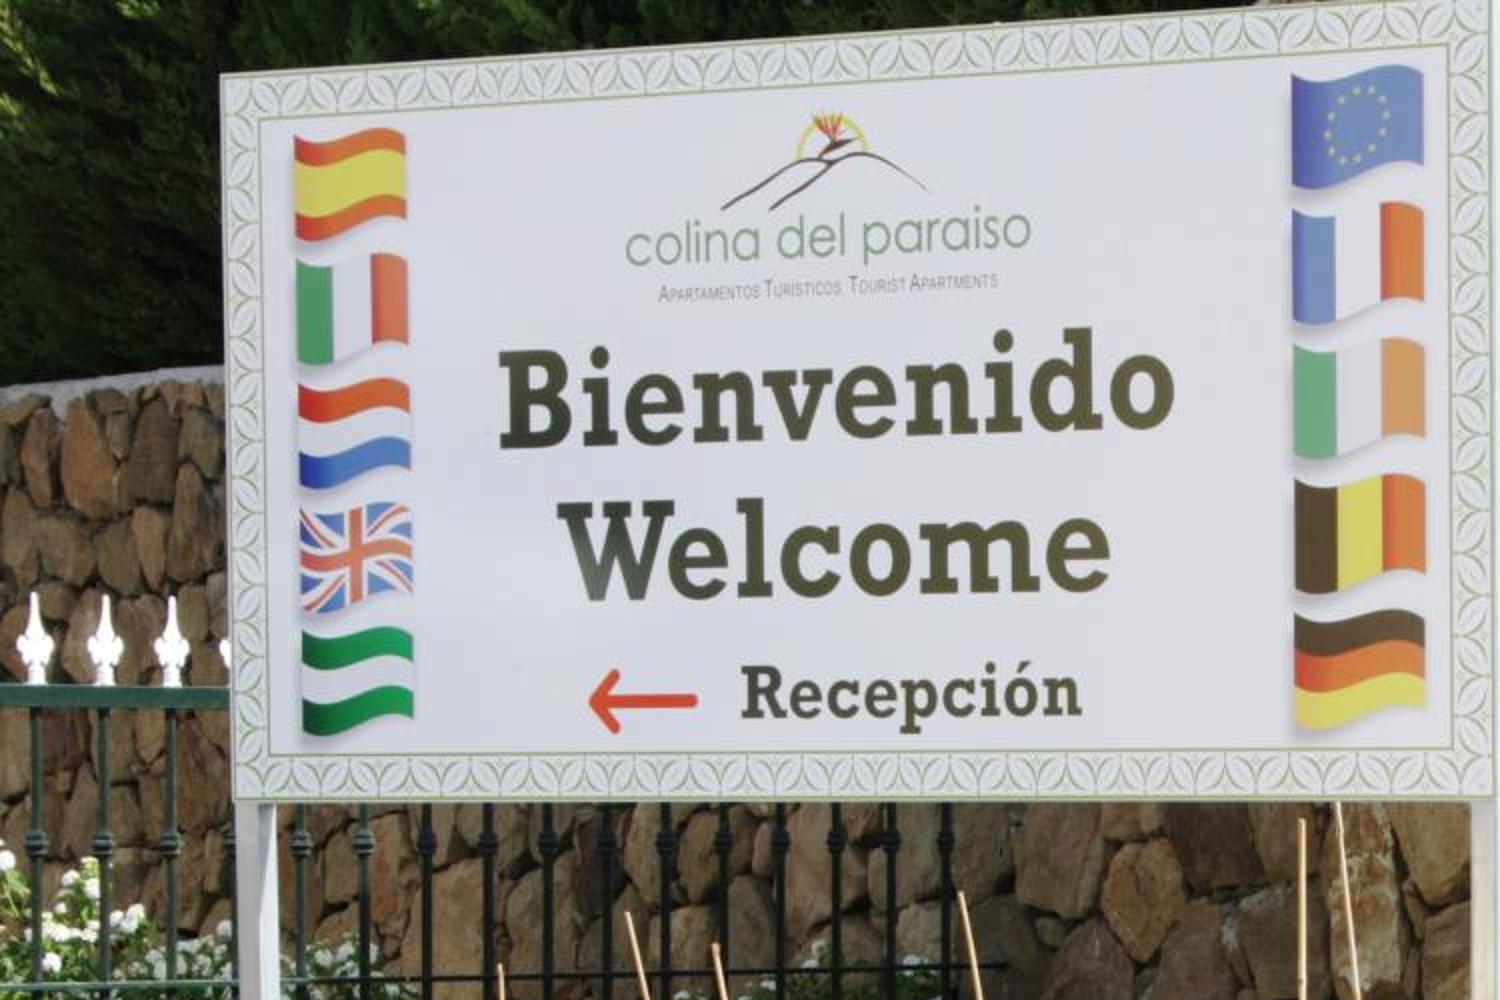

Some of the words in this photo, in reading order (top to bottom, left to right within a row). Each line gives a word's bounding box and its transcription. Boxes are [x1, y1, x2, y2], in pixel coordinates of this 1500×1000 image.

[626, 220, 760, 266] colina
[777, 212, 846, 259] del
[863, 205, 1031, 266] paraiso
[658, 284, 761, 302] APARTAMENTOS
[848, 275, 906, 294] TOURIST
[910, 272, 999, 291] APARTMENTS
[500, 326, 1174, 449] Bienvenido
[557, 497, 1110, 601] Welcome
[741, 661, 1082, 735] Recepción
